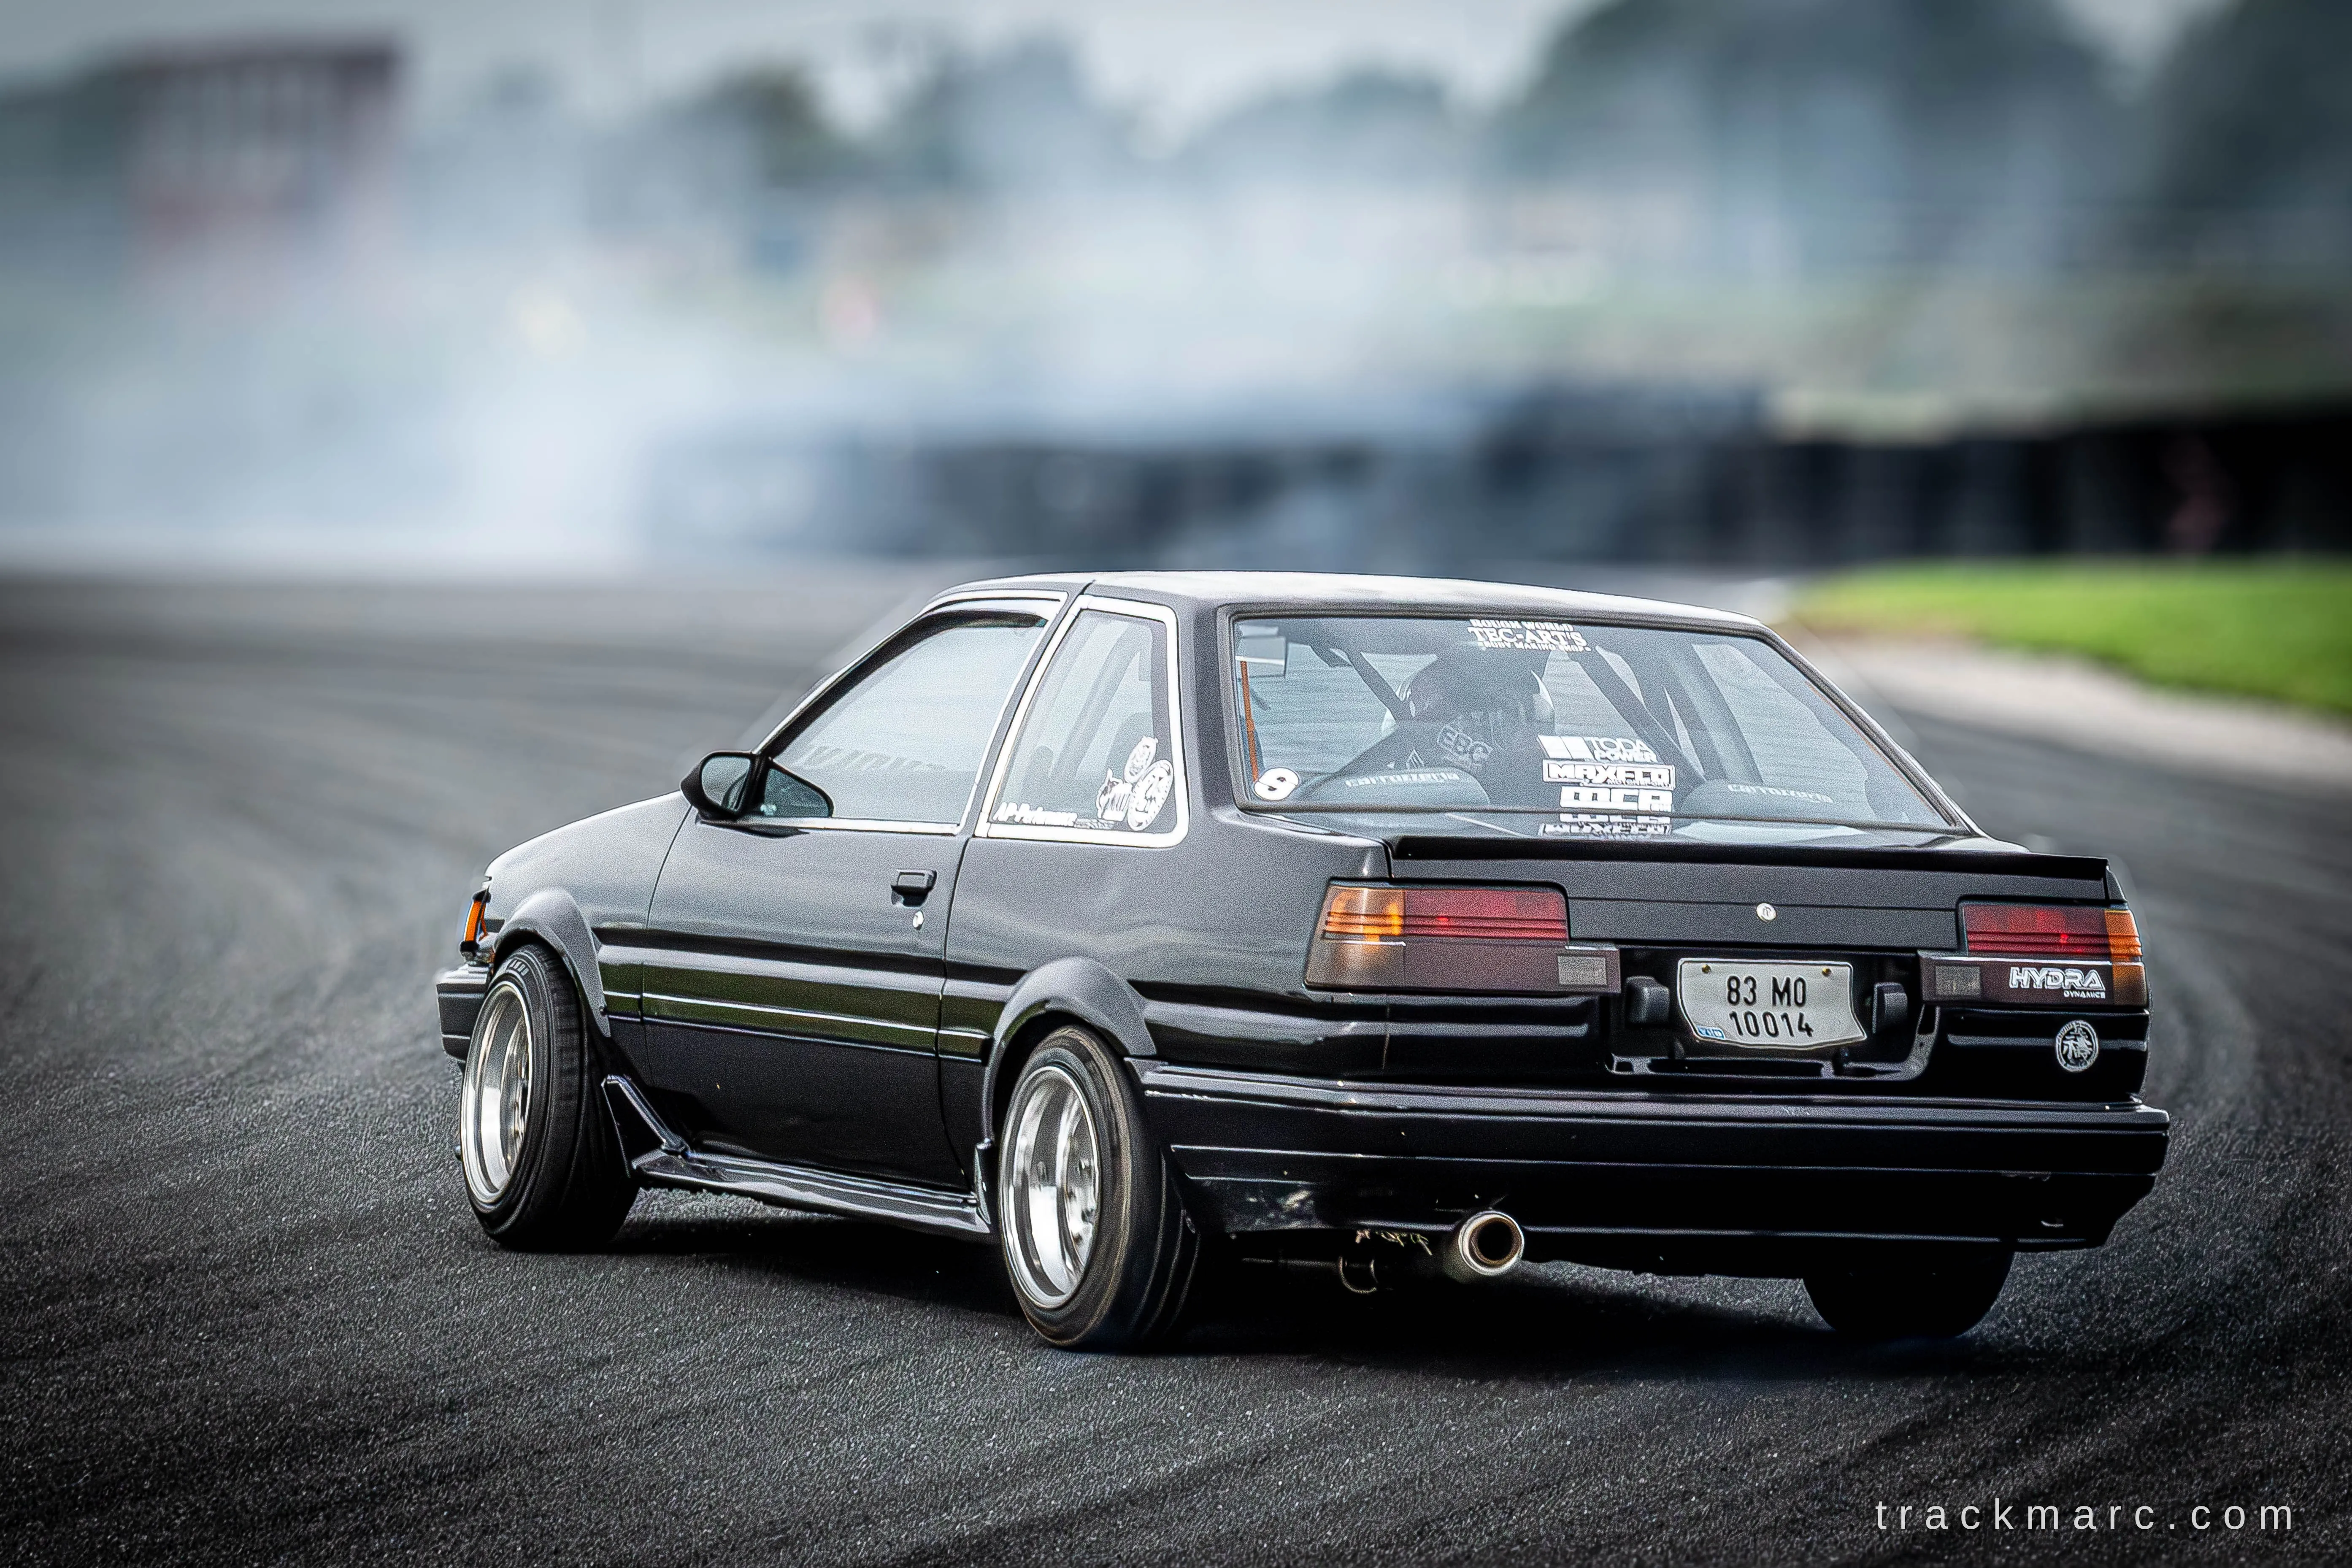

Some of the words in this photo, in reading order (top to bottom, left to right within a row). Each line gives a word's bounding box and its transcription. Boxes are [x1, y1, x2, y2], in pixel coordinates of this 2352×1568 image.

[1522, 621, 1573, 631] WORLD
[1467, 627, 1587, 646] TEC-ART'S
[1585, 737, 1653, 753] TODA
[1594, 750, 1658, 762] POWER
[2009, 967, 2106, 990] HYDRA
[1727, 975, 1757, 1006] 83
[1730, 1011, 1814, 1038] 10014
